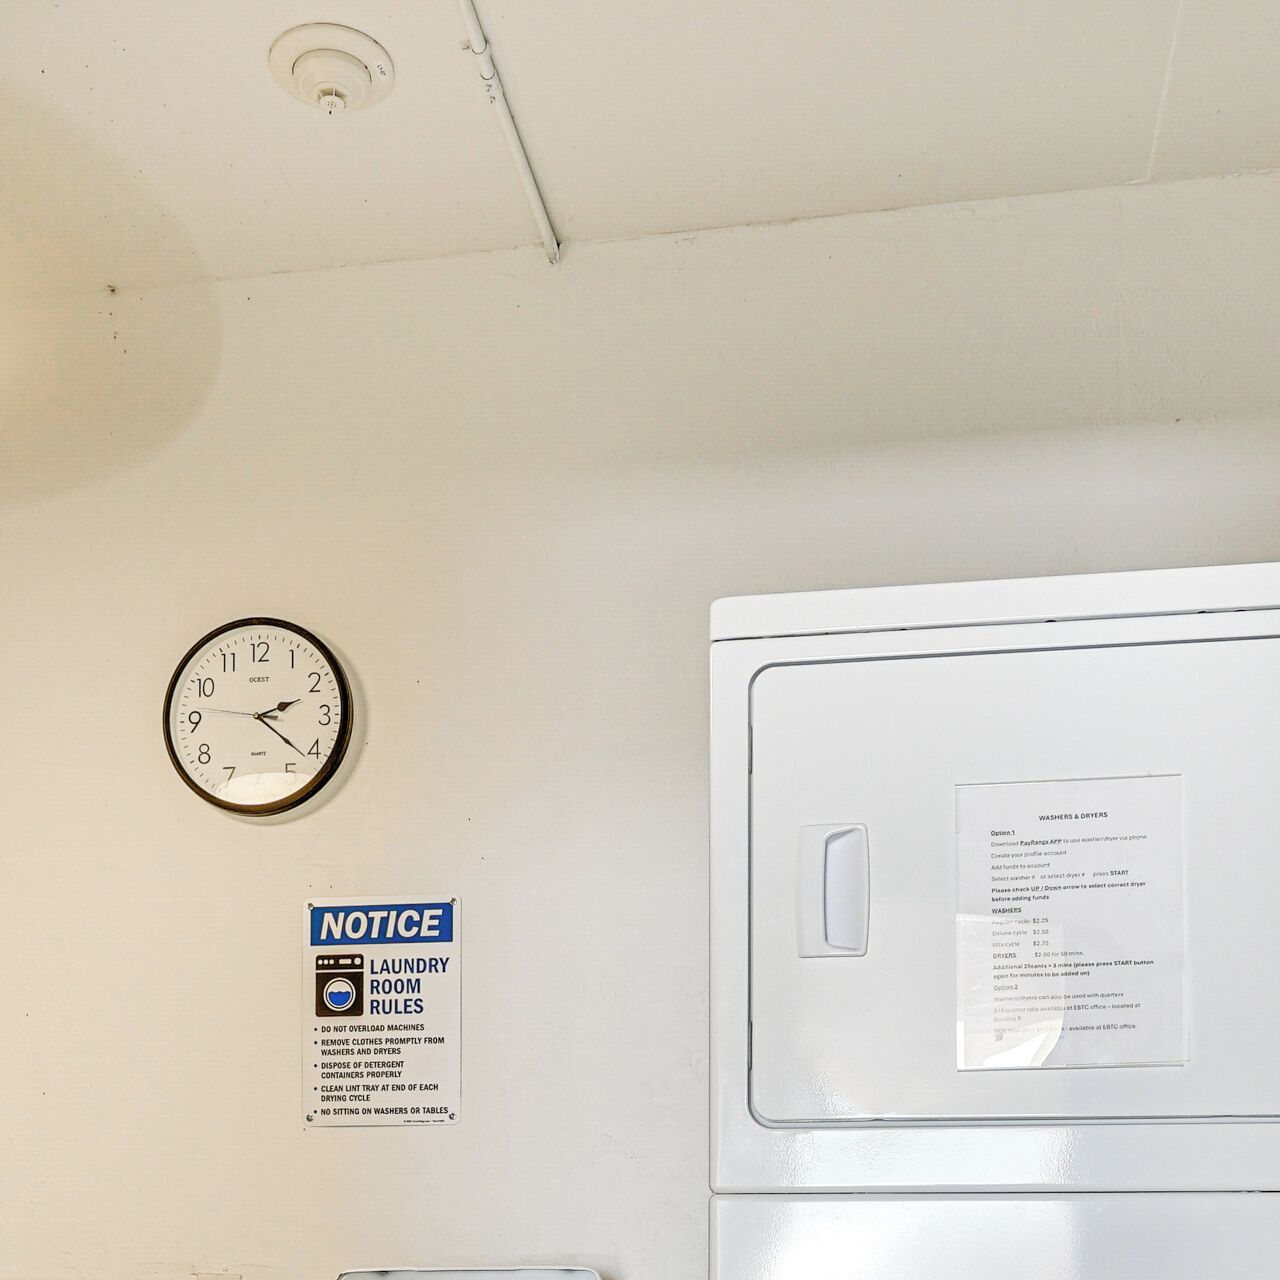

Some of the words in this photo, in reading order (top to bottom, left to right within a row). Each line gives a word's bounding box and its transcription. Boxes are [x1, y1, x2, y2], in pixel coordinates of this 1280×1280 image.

[221, 652, 236, 672] 11
[250, 641, 270, 663] 12
[289, 650, 295, 669] 1
[196, 677, 215, 698] 10
[308, 672, 321, 693] 2
[188, 711, 202, 733] 9
[318, 704, 331, 726] 3
[198, 743, 211, 764] 8
[307, 738, 321, 759] 4
[320, 909, 443, 940] NOTICE
[370, 958, 449, 975] LAUNDRY
[370, 978, 421, 994] ROOM
[370, 999, 424, 1015] RULES
